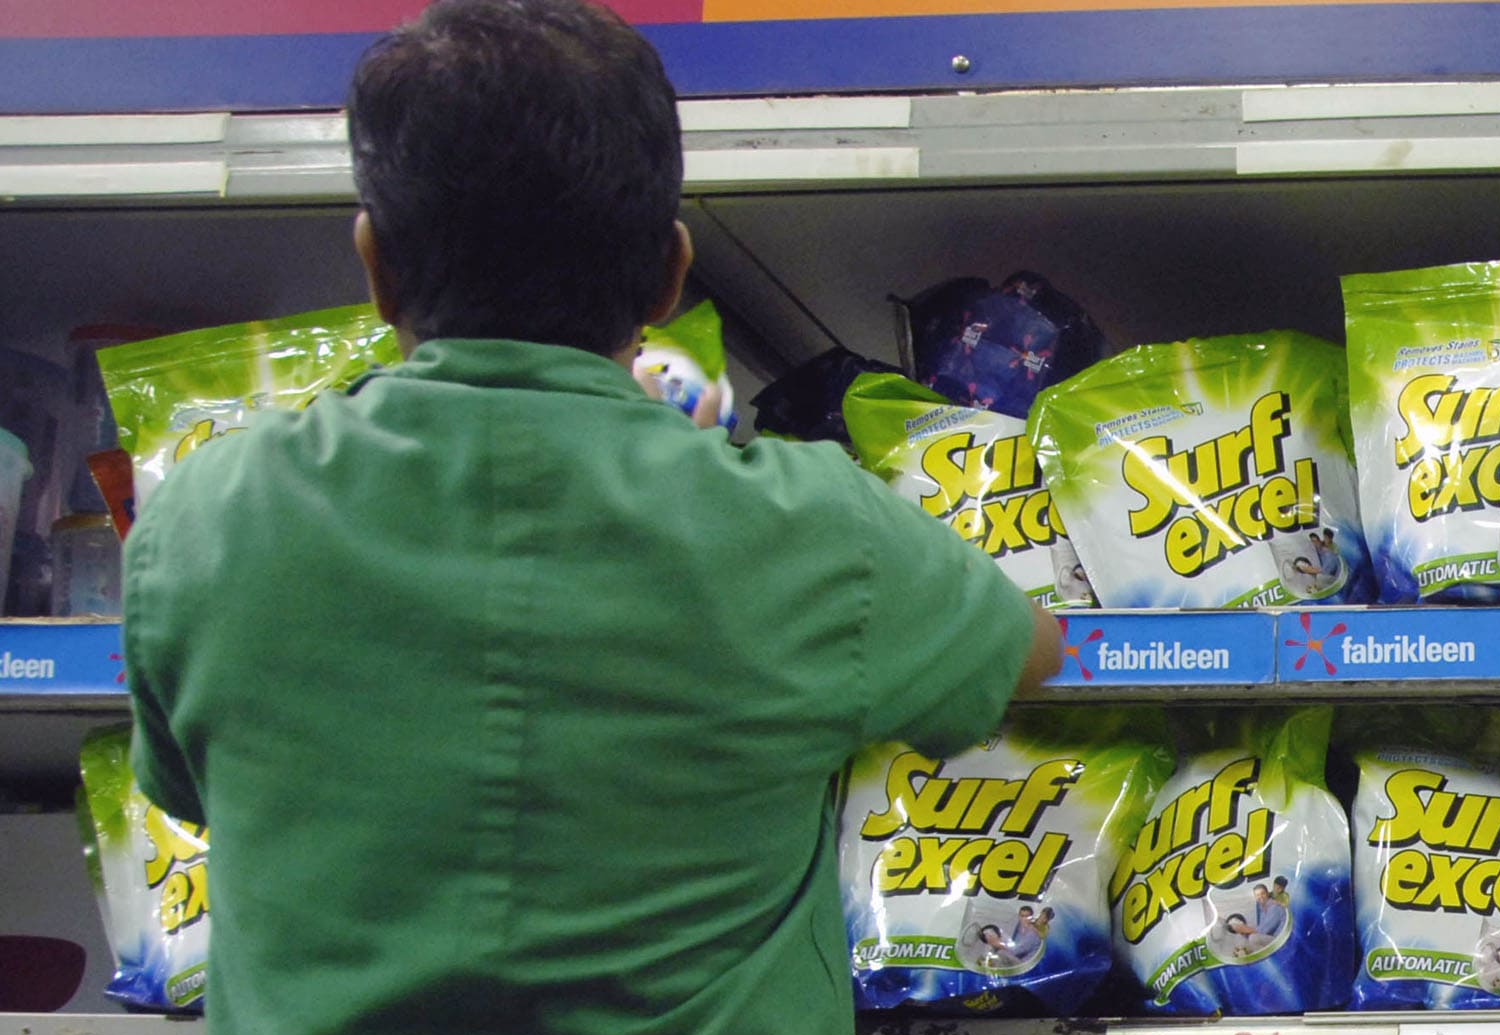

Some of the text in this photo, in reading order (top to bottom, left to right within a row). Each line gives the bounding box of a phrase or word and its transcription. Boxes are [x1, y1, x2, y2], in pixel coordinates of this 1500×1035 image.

[920, 432, 1040, 517] Sur
[1122, 391, 1291, 539] Surf
[1163, 458, 1319, 579] excel
[1098, 642, 1230, 671] fabrikleen
[1341, 635, 1476, 665] fabrikleen
[860, 750, 1088, 842] Surf
[871, 832, 1074, 902] excel
[1121, 806, 1275, 945] excel
[857, 942, 954, 962] AUTOMATIC
[1371, 955, 1471, 977] AUTOMATIC
